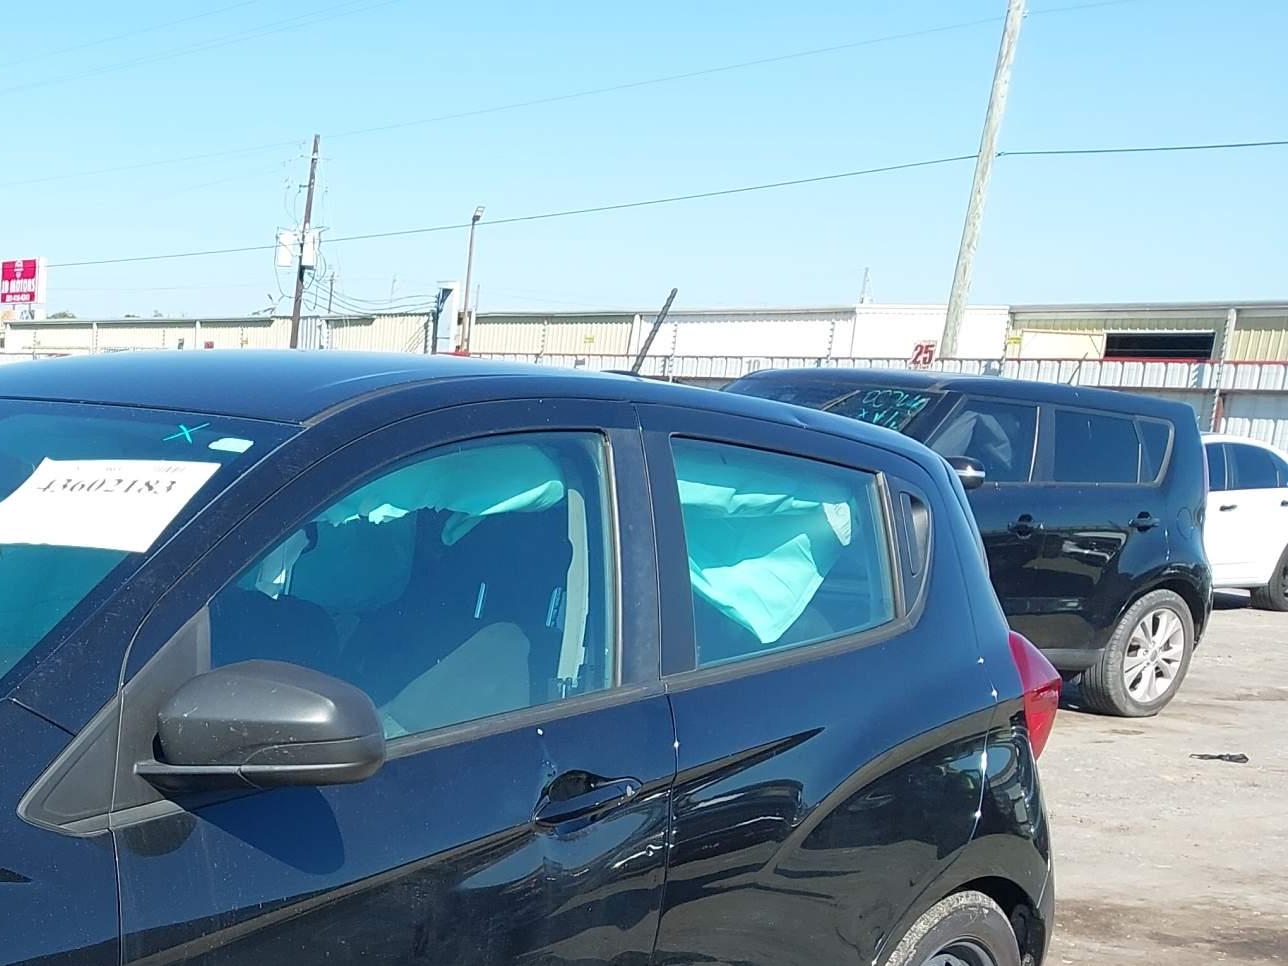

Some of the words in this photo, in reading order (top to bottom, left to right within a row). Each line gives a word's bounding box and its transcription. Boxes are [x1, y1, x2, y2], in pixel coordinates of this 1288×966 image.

[10, 279, 35, 293] MOTORS
[912, 344, 935, 364] 25
[37, 478, 177, 494] 43602183
